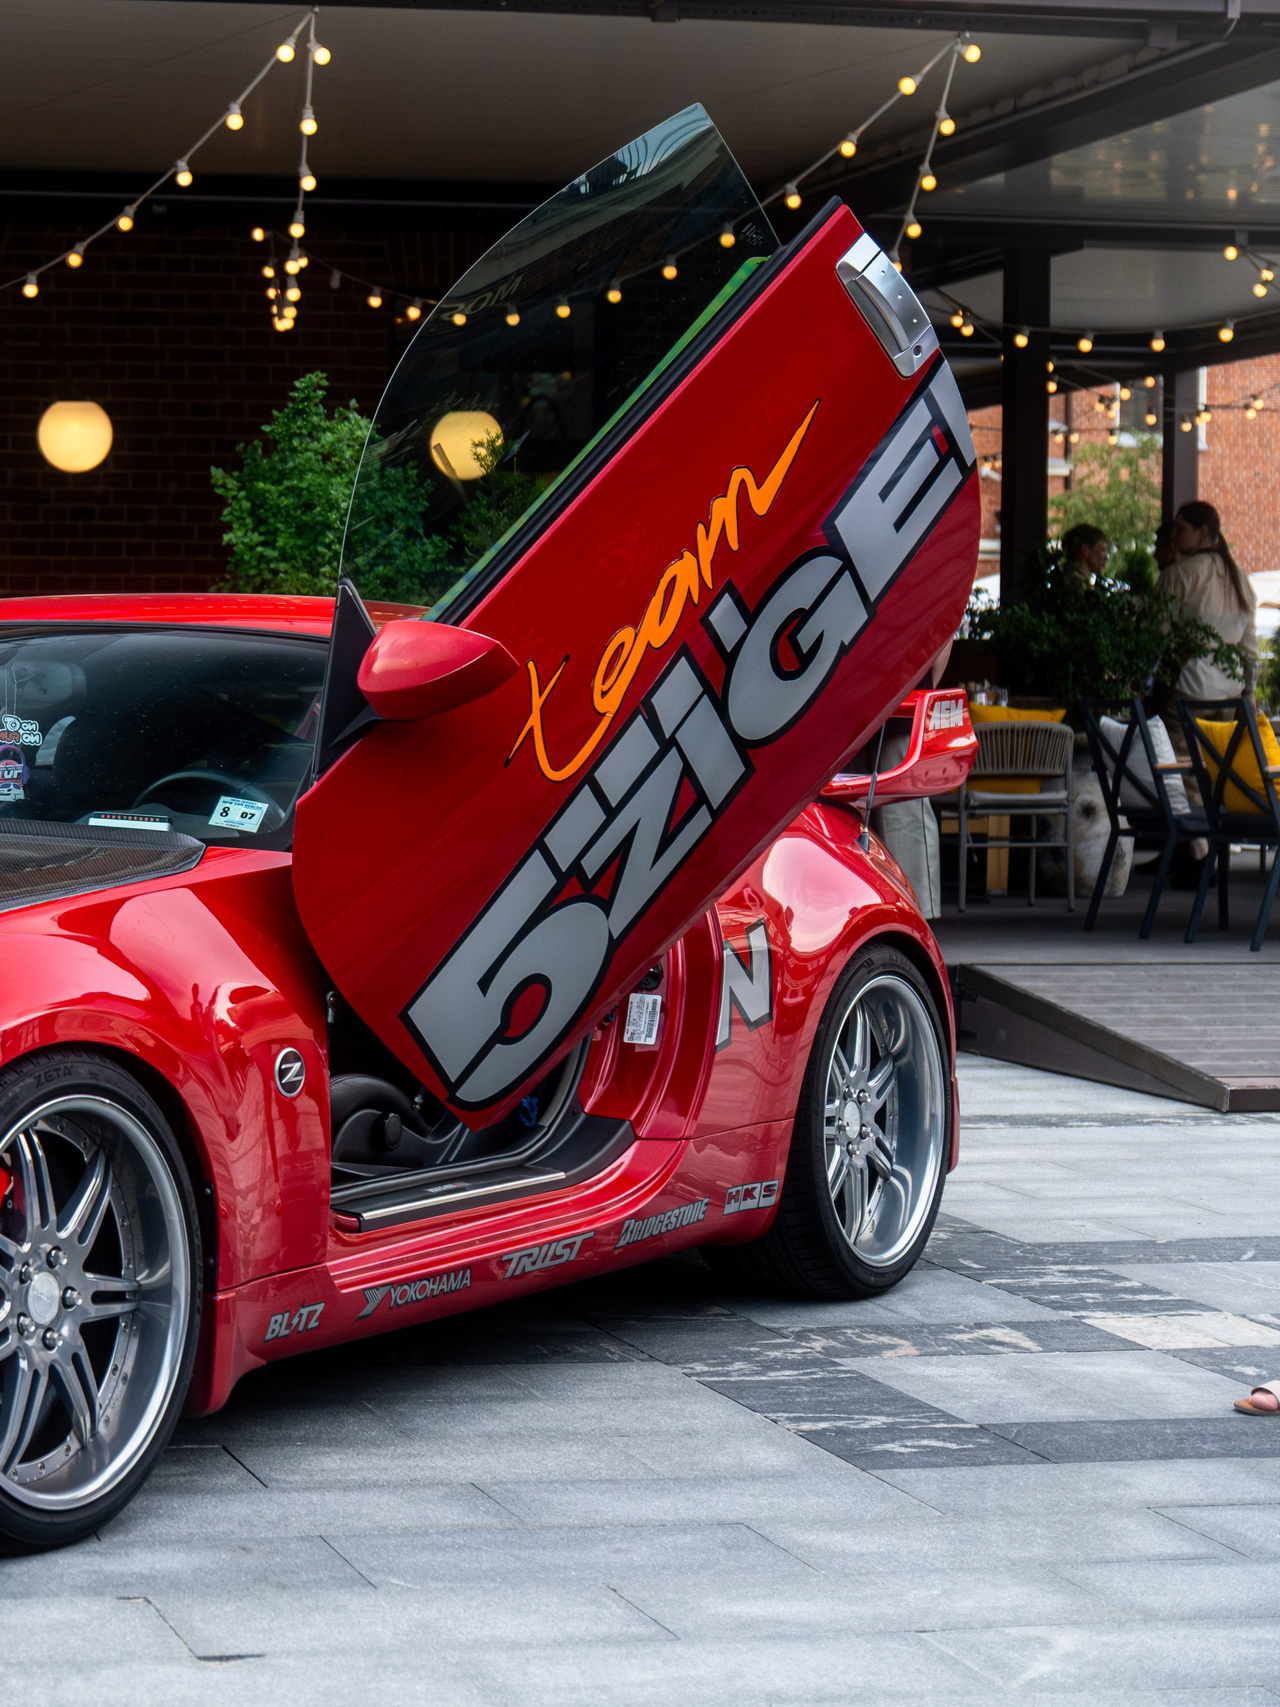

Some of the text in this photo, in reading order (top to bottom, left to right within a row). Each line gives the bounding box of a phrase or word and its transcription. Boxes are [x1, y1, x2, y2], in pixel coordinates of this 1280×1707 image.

[505, 398, 820, 783] team
[928, 698, 964, 731] AEM
[220, 806, 256, 820] 8 07
[715, 917, 773, 1055] N
[33, 1065, 74, 1089] ZETA
[281, 1062, 304, 1083] Z
[724, 1180, 779, 1211] HKS
[614, 1197, 710, 1250] BRIDGESTONE
[501, 1231, 595, 1279] TRUST
[388, 1266, 472, 1310] YOKOHAMA
[263, 1300, 326, 1343] BLITZ
